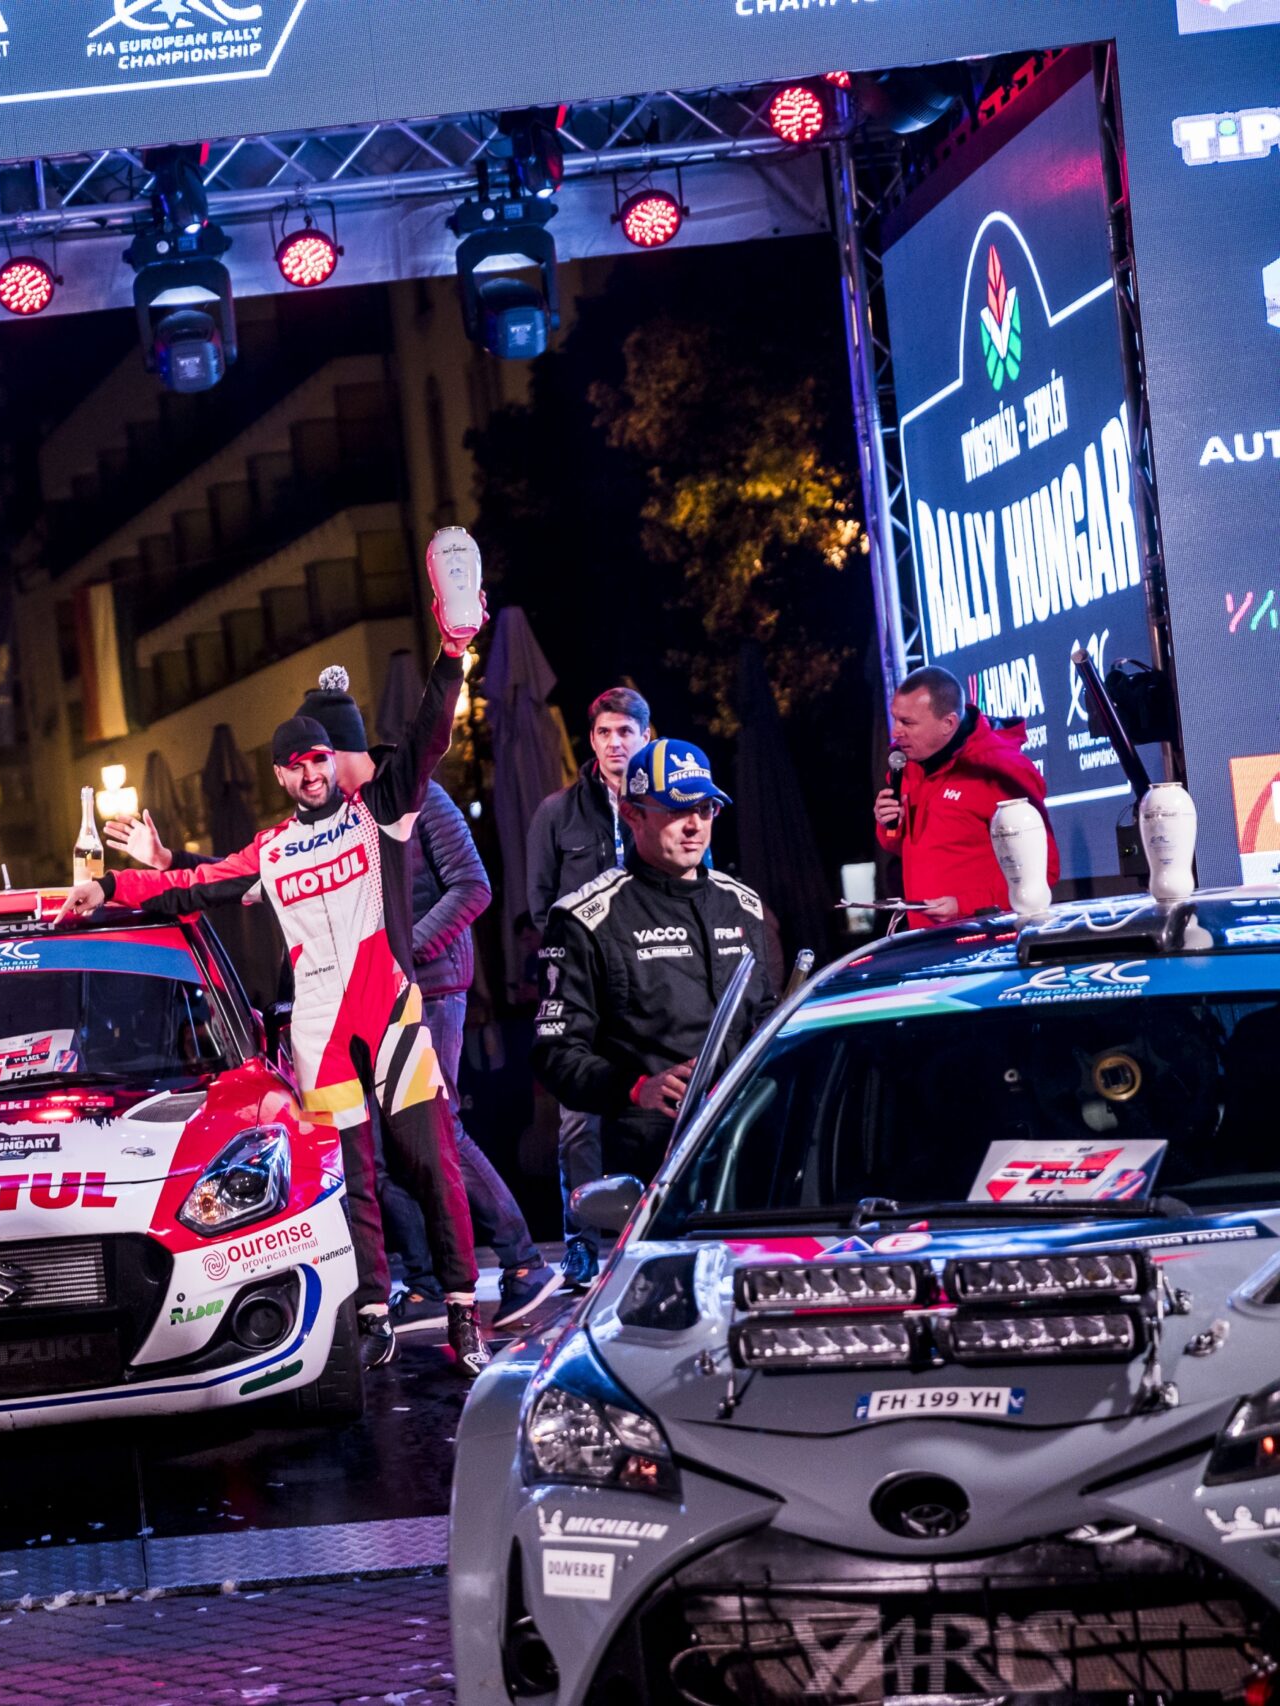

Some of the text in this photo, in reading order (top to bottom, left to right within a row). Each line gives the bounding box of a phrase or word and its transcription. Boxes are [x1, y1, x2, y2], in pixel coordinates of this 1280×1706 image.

[86, 26, 263, 57] FIA EUROPEAN RALLY
[117, 42, 263, 70] CHAMPIONSHIP
[916, 399, 1141, 658] RALLY HUNGAR
[982, 653, 1045, 718] HUMDA
[284, 813, 361, 857] SUZUKI
[281, 851, 365, 902] MOTUL
[581, 902, 602, 918] OMP
[633, 926, 688, 943] YACCO
[998, 983, 1146, 1001] FIA EUROPEAN RALLY
[1021, 988, 1143, 1005] CHAMPIONSHIP
[1056, 1169, 1087, 1179] PLACE
[227, 1221, 314, 1263] ourense
[1186, 1228, 1259, 1243] FRANCE
[241, 1237, 319, 1272] provincia termal
[876, 1391, 907, 1411] FH
[917, 1391, 959, 1409] 199
[969, 1389, 1002, 1409] YH
[563, 1516, 669, 1540] MICHELIN
